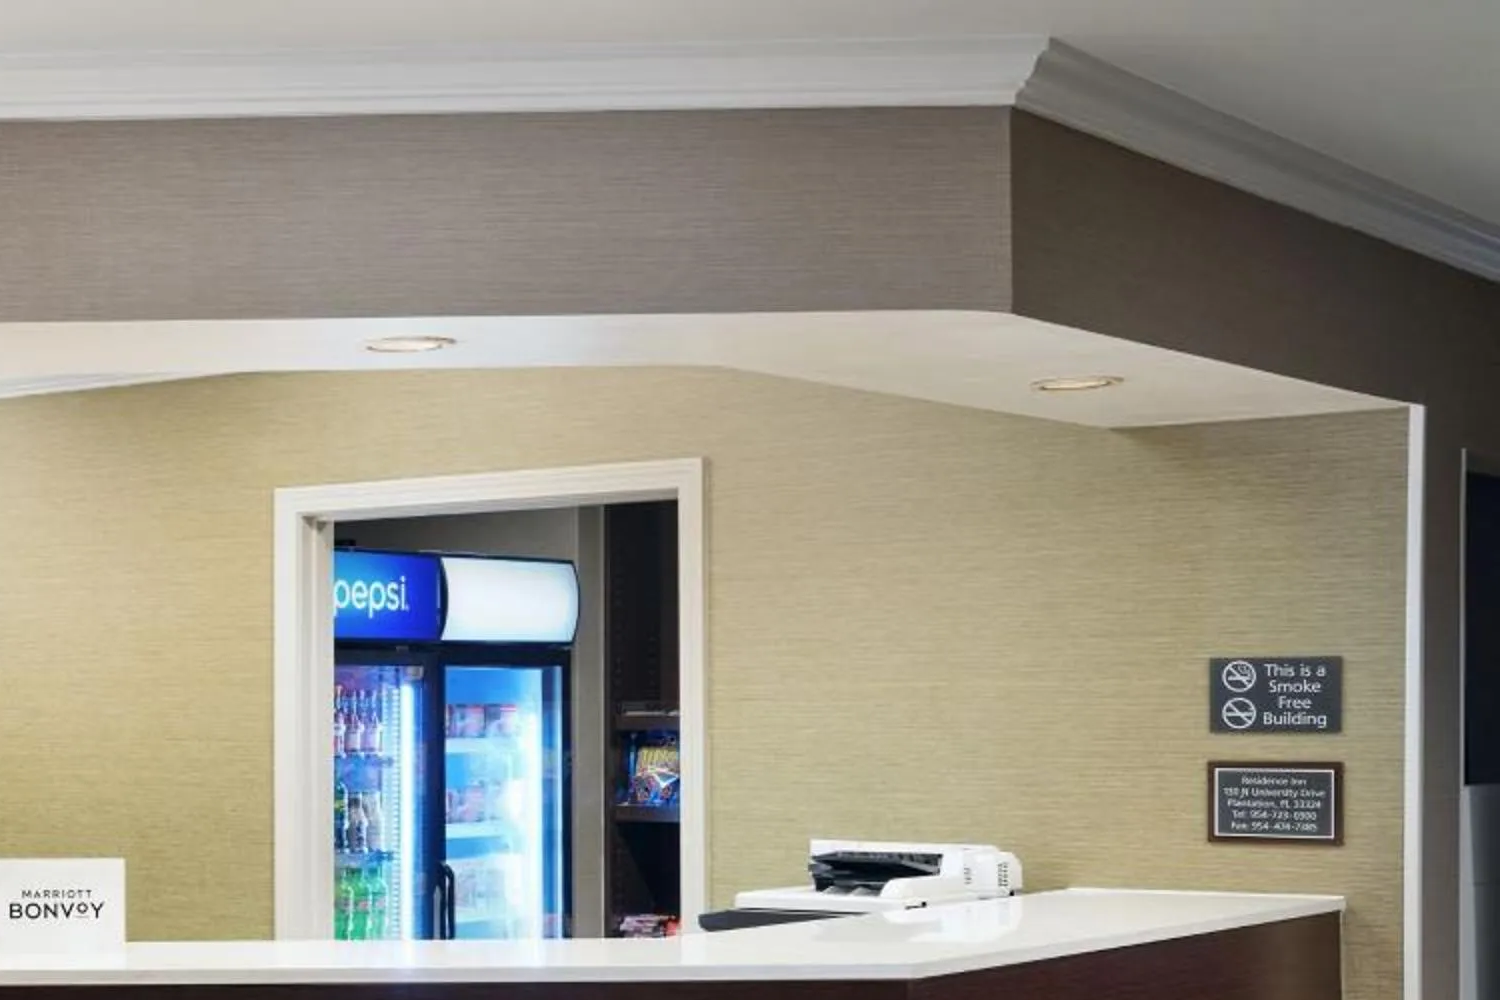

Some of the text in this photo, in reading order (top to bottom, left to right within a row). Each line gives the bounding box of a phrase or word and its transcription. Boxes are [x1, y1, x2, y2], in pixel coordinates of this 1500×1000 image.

[333, 575, 406, 618] pepsi
[1264, 664, 1326, 677] This is a
[1268, 679, 1322, 693] Smoke
[1278, 695, 1313, 709] Free
[1263, 711, 1327, 729] Building
[21, 889, 93, 899] MARRIOTT
[8, 901, 105, 920] BONVOY
